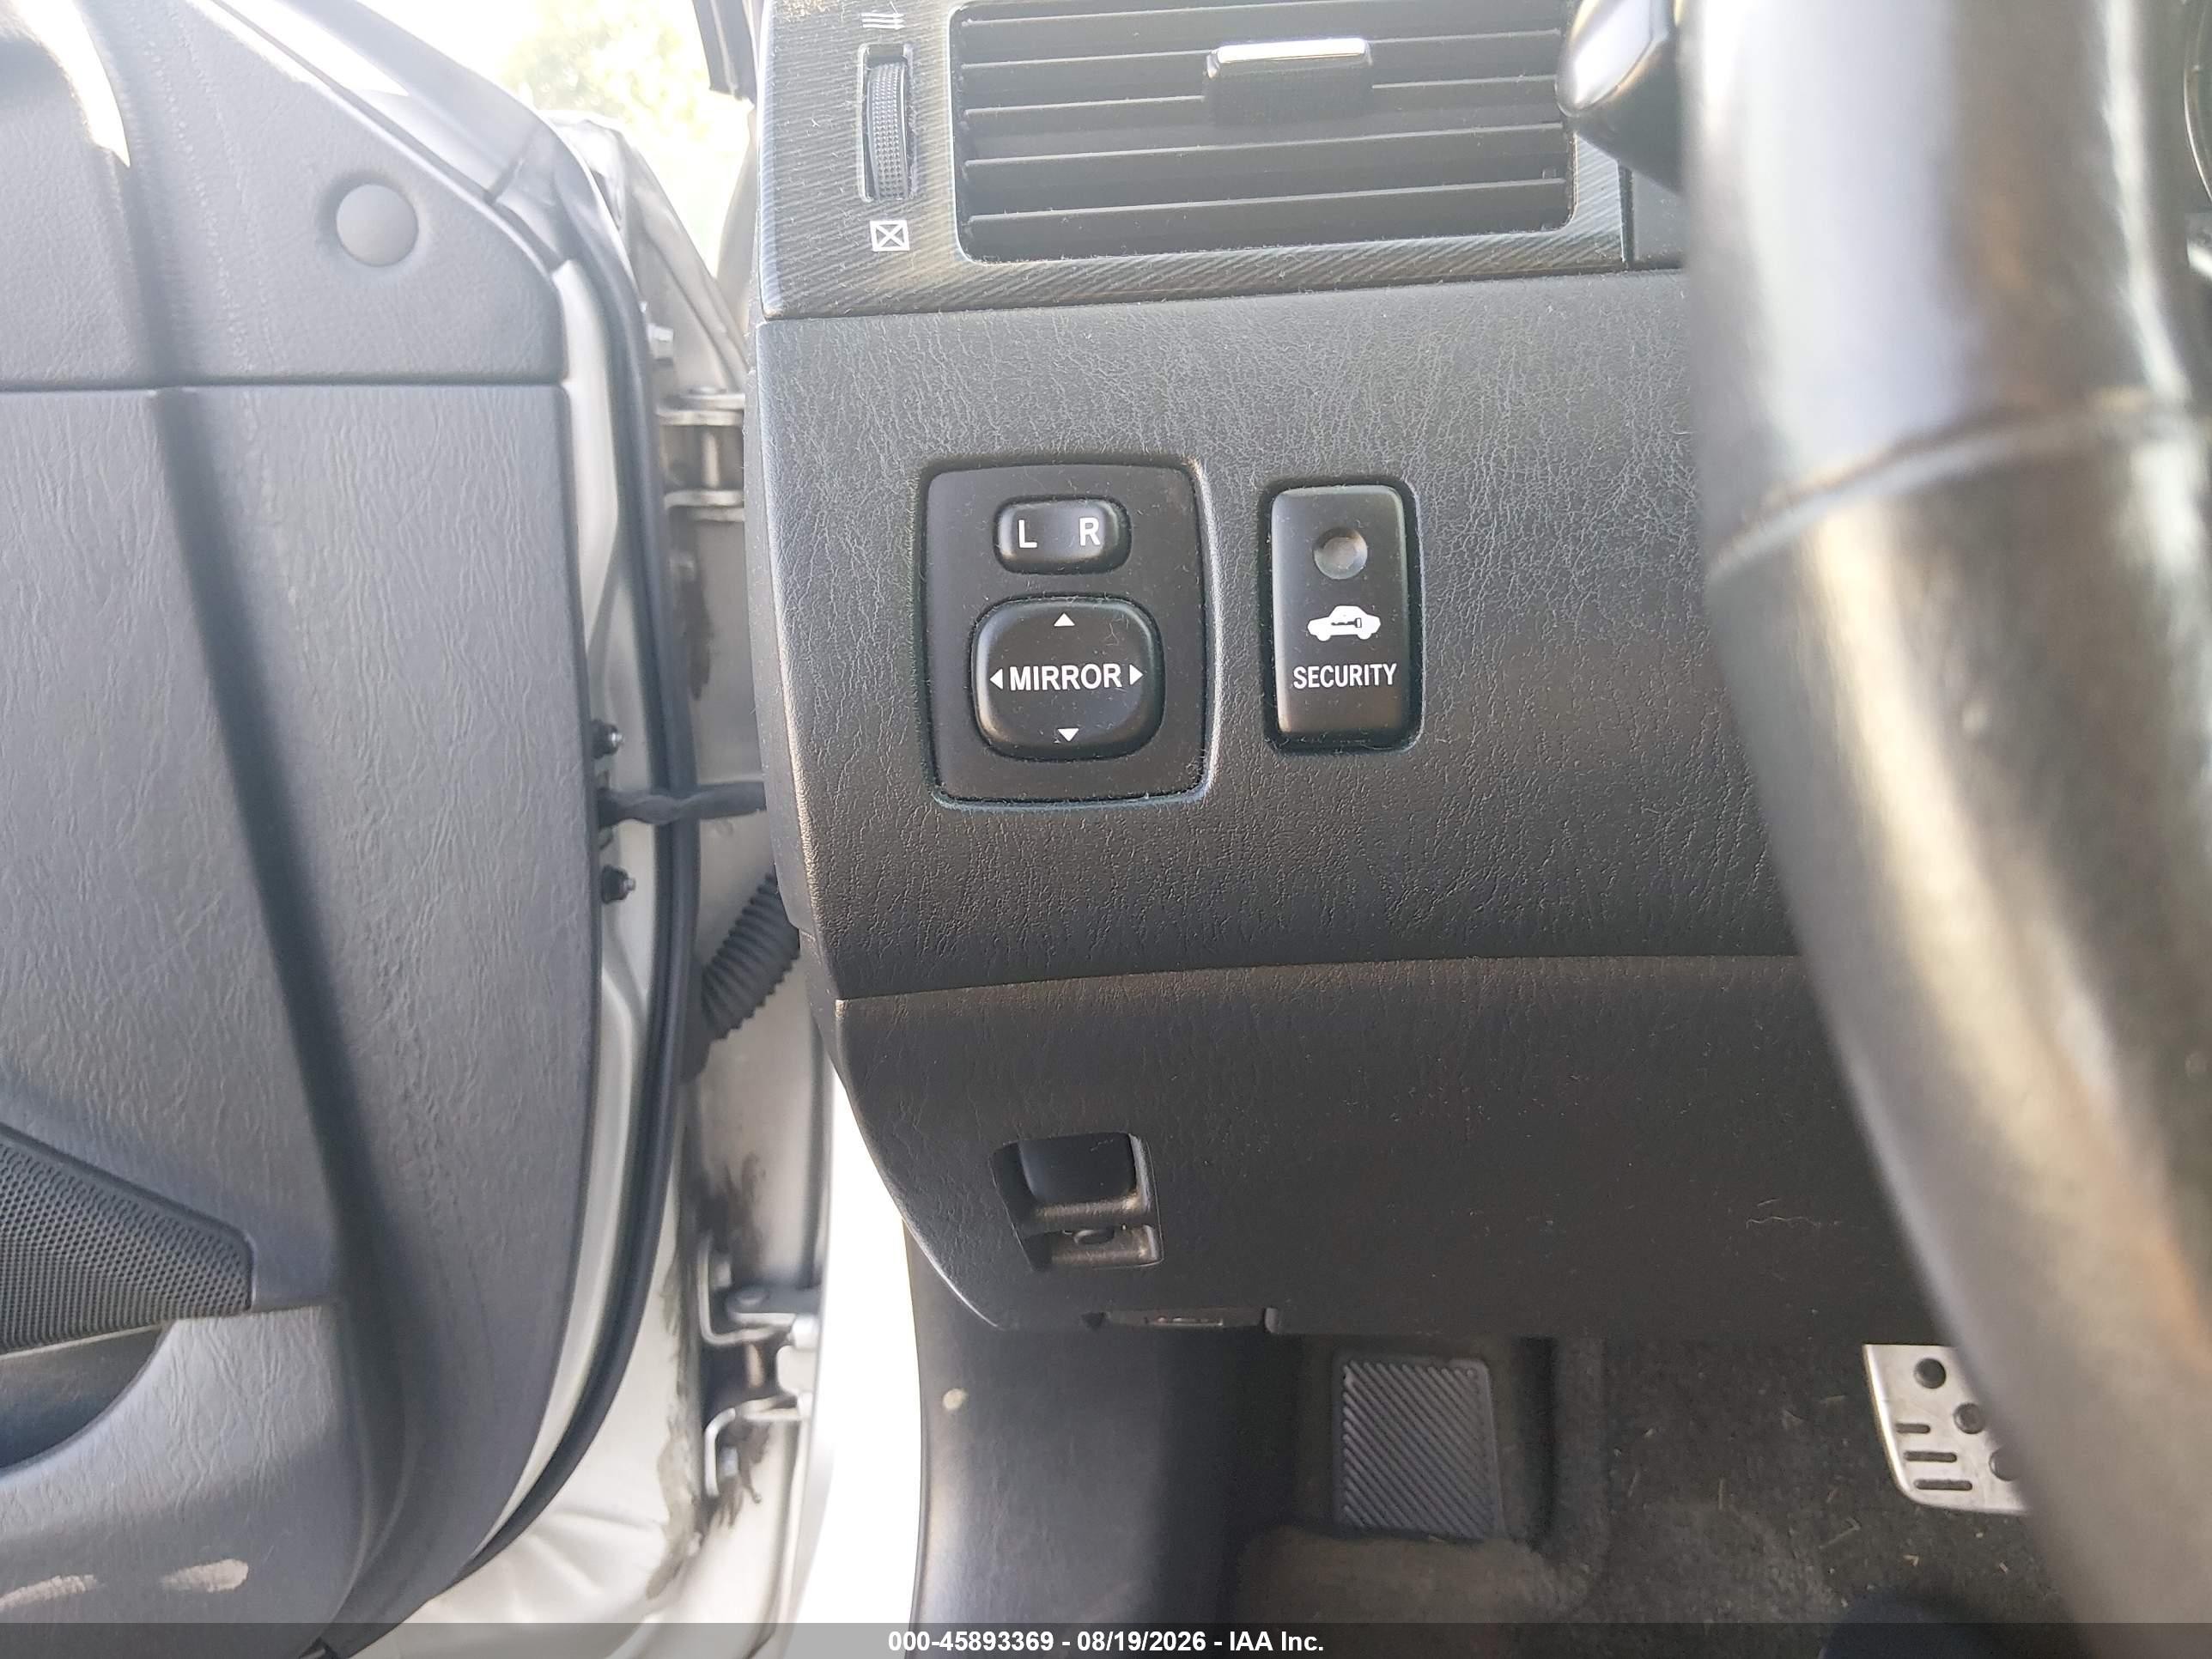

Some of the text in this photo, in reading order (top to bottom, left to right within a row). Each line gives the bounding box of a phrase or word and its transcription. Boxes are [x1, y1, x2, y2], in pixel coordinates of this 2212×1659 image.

[1018, 519, 1101, 549] L R
[1009, 662, 1123, 692] MIRROR
[1291, 663, 1397, 690] SECURITY
